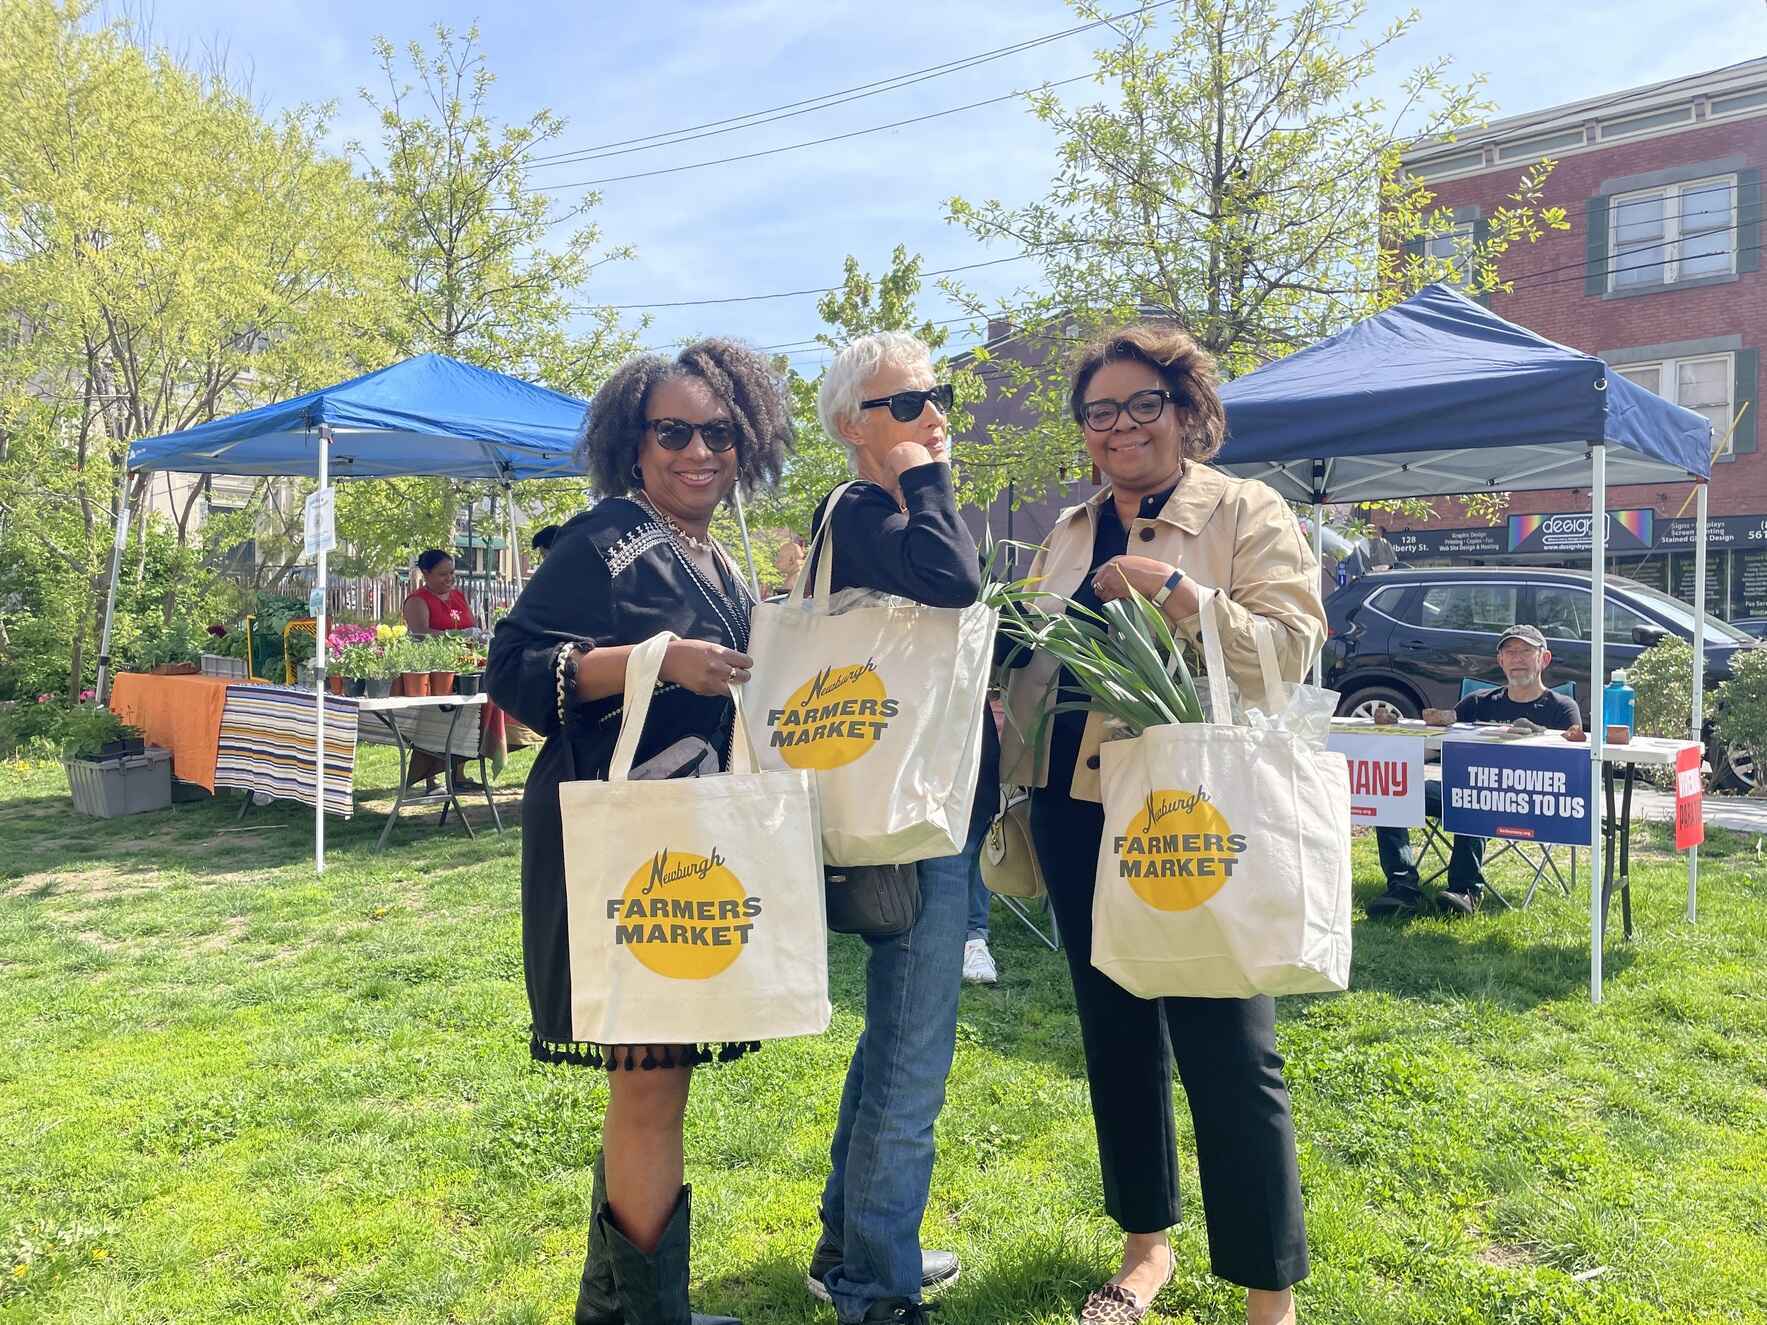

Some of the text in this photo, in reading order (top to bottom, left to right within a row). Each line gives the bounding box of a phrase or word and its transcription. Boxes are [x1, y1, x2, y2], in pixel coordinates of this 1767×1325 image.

[1671, 522, 1690, 530] Signs
[1392, 544, 1430, 553] iberty St.
[1401, 536, 1417, 544] 128
[1661, 536, 1689, 544] Stained
[1709, 534, 1735, 542] Design
[800, 656, 878, 707] Newburgh
[767, 698, 899, 727] FARMERS
[769, 720, 889, 748] MARKET
[1467, 766, 1566, 793] THE POWER
[1451, 787, 1585, 819] BELONGS TO US
[1113, 833, 1248, 854] FARMERS
[641, 845, 726, 895] Newburgh
[1119, 857, 1239, 878] MARKET
[606, 896, 763, 921] FARMERS
[615, 923, 754, 946] MARKET
